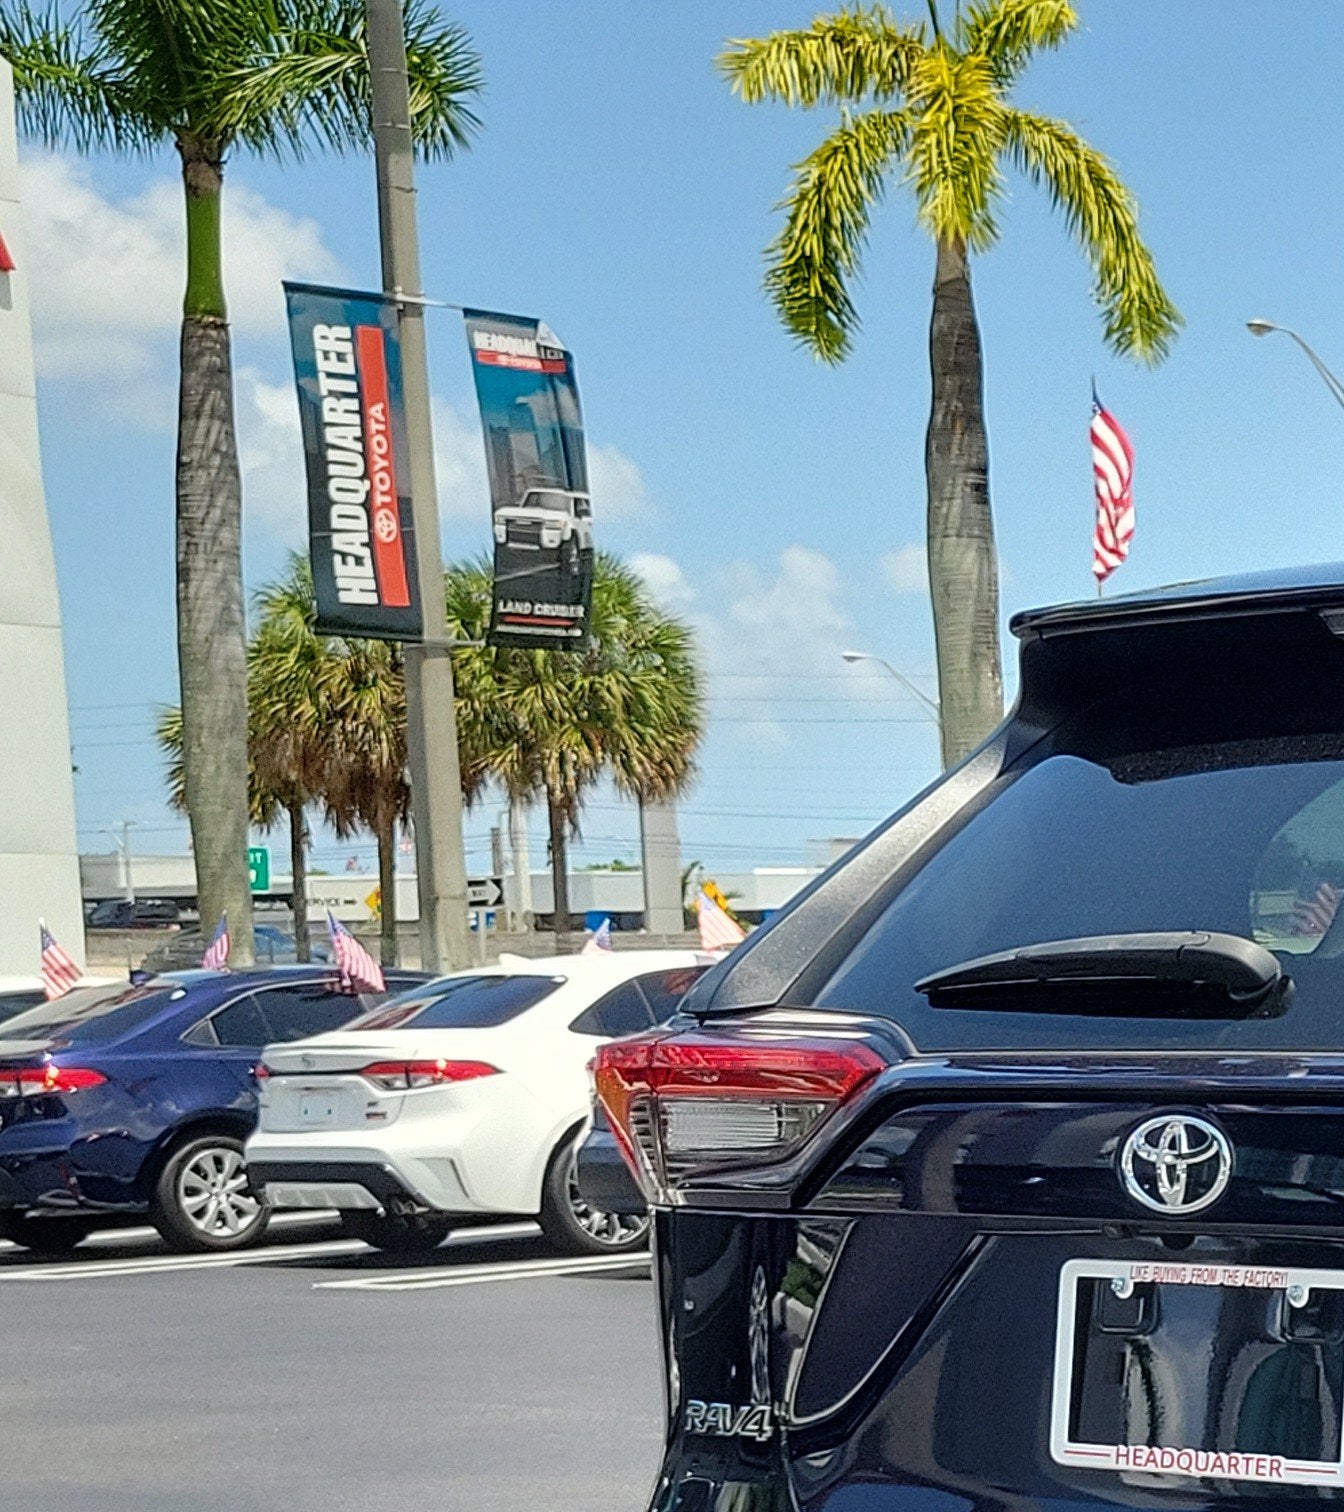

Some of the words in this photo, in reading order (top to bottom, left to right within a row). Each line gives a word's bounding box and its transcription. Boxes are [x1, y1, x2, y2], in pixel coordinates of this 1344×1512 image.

[313, 324, 379, 605] HEADQUARTER
[369, 402, 392, 505] TOYOTA
[497, 599, 532, 615] LAND
[533, 602, 585, 618] CRUISER
[1130, 1265, 1149, 1280] LIKE
[1153, 1266, 1187, 1283] BUYING
[1191, 1268, 1218, 1283] FROM
[1222, 1269, 1240, 1284] THE
[685, 1400, 773, 1441] RAV4
[1115, 1448, 1283, 1478] HEADQUARTER
